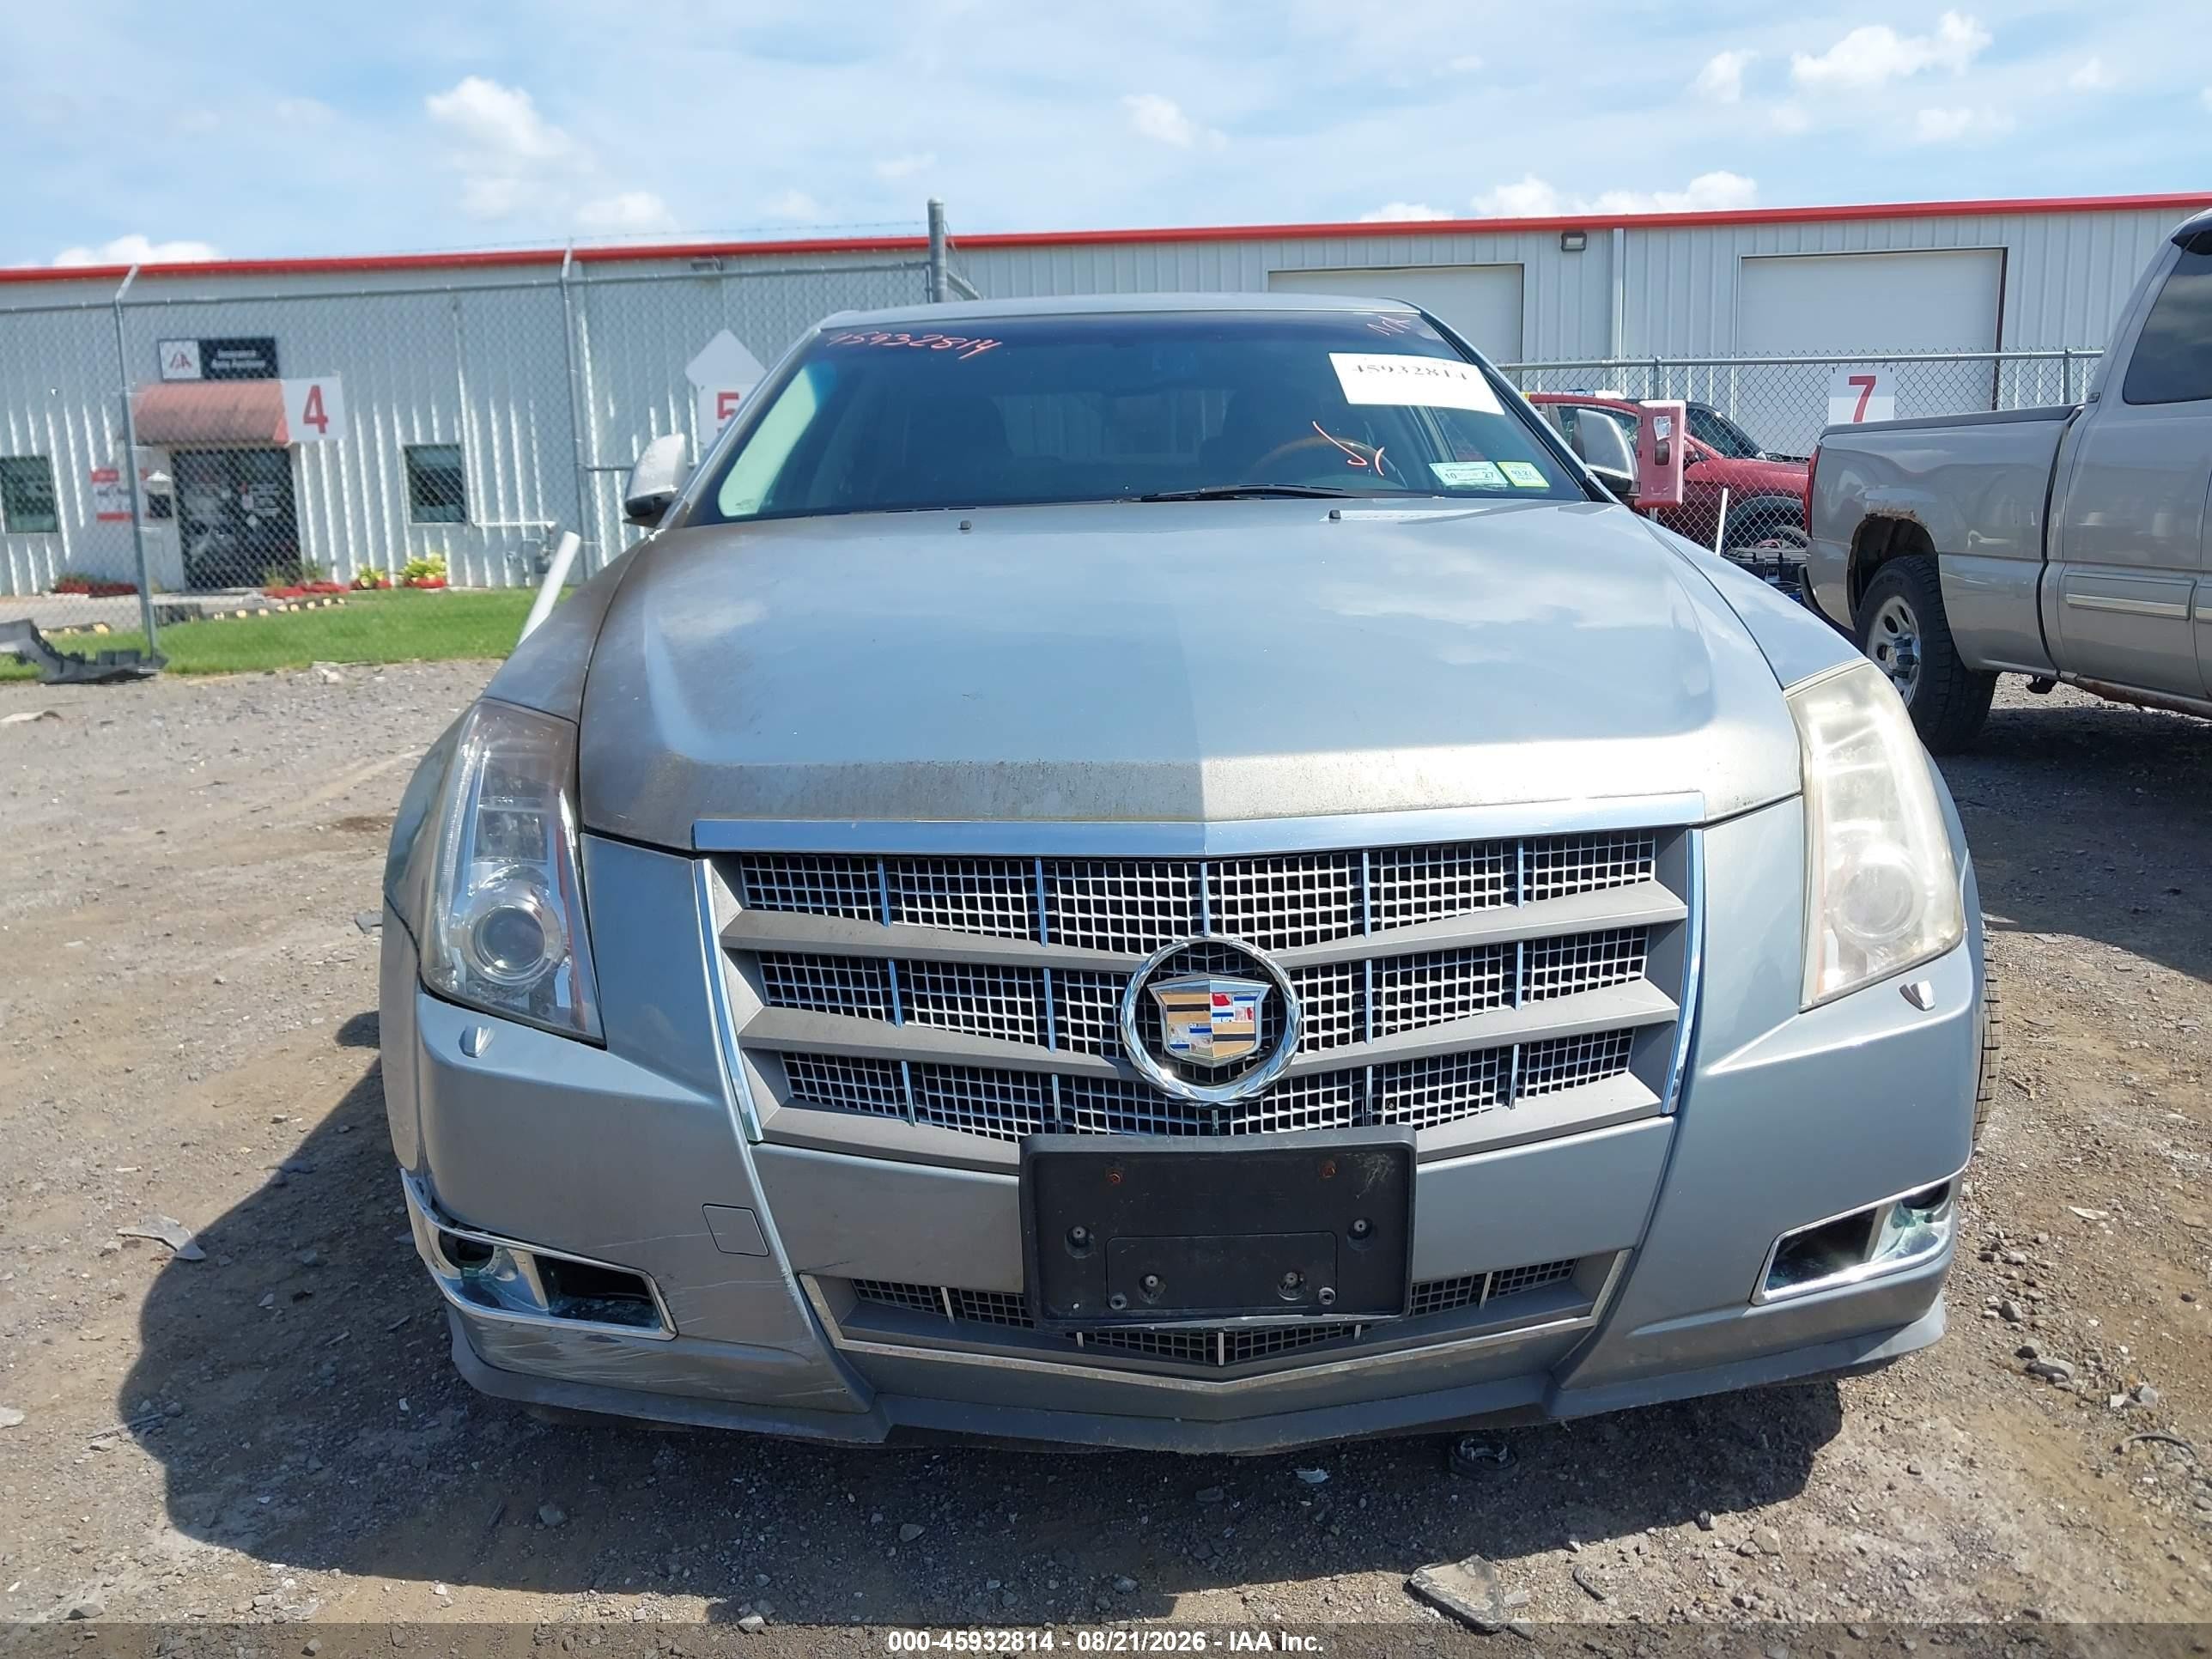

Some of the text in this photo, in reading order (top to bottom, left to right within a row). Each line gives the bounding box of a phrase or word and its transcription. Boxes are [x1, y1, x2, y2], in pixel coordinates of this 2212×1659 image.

[303, 385, 329, 434] 4
[717, 392, 739, 433] 5
[1849, 375, 1876, 423] 7
